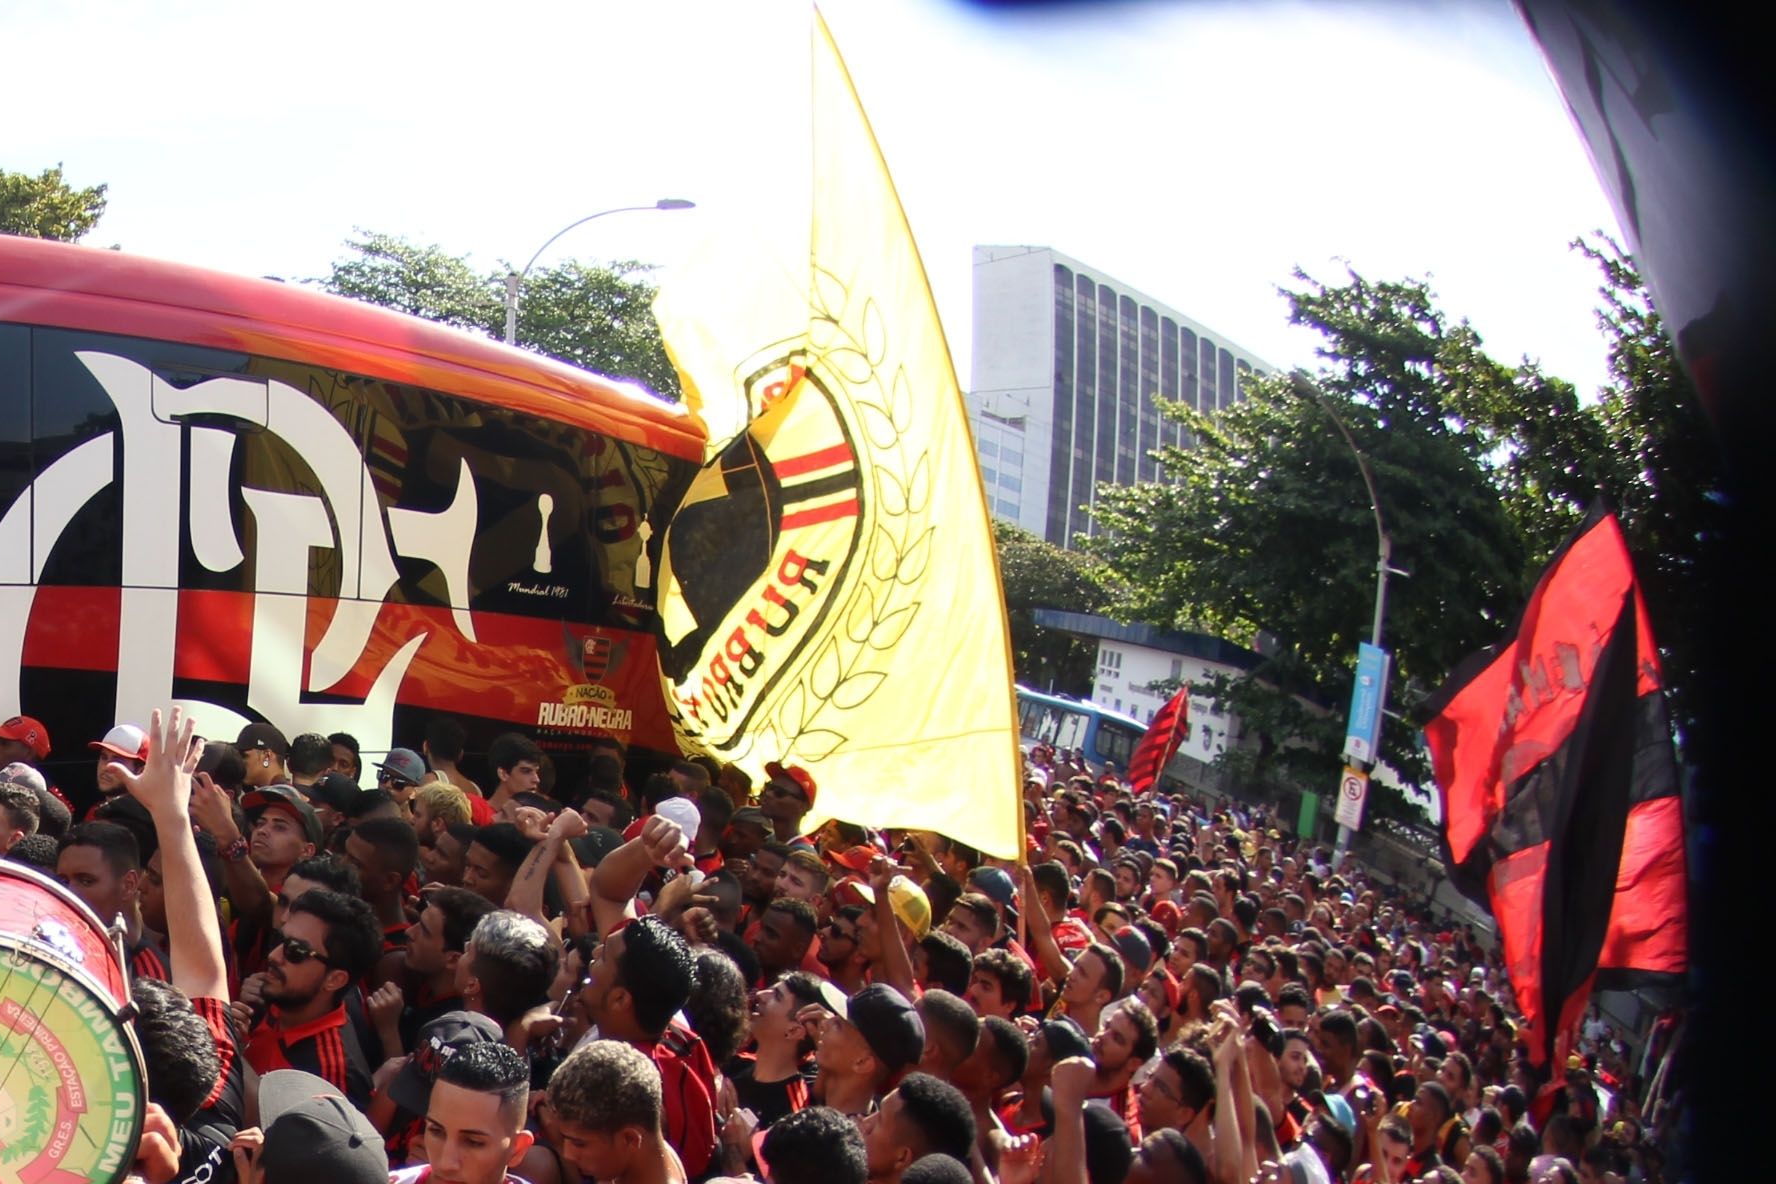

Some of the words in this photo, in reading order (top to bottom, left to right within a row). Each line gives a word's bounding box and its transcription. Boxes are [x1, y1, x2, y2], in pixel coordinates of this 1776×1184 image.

[507, 582, 550, 597] Mundial
[576, 685, 608, 700] NAÇÃO
[98, 1092, 136, 1174] MEU
